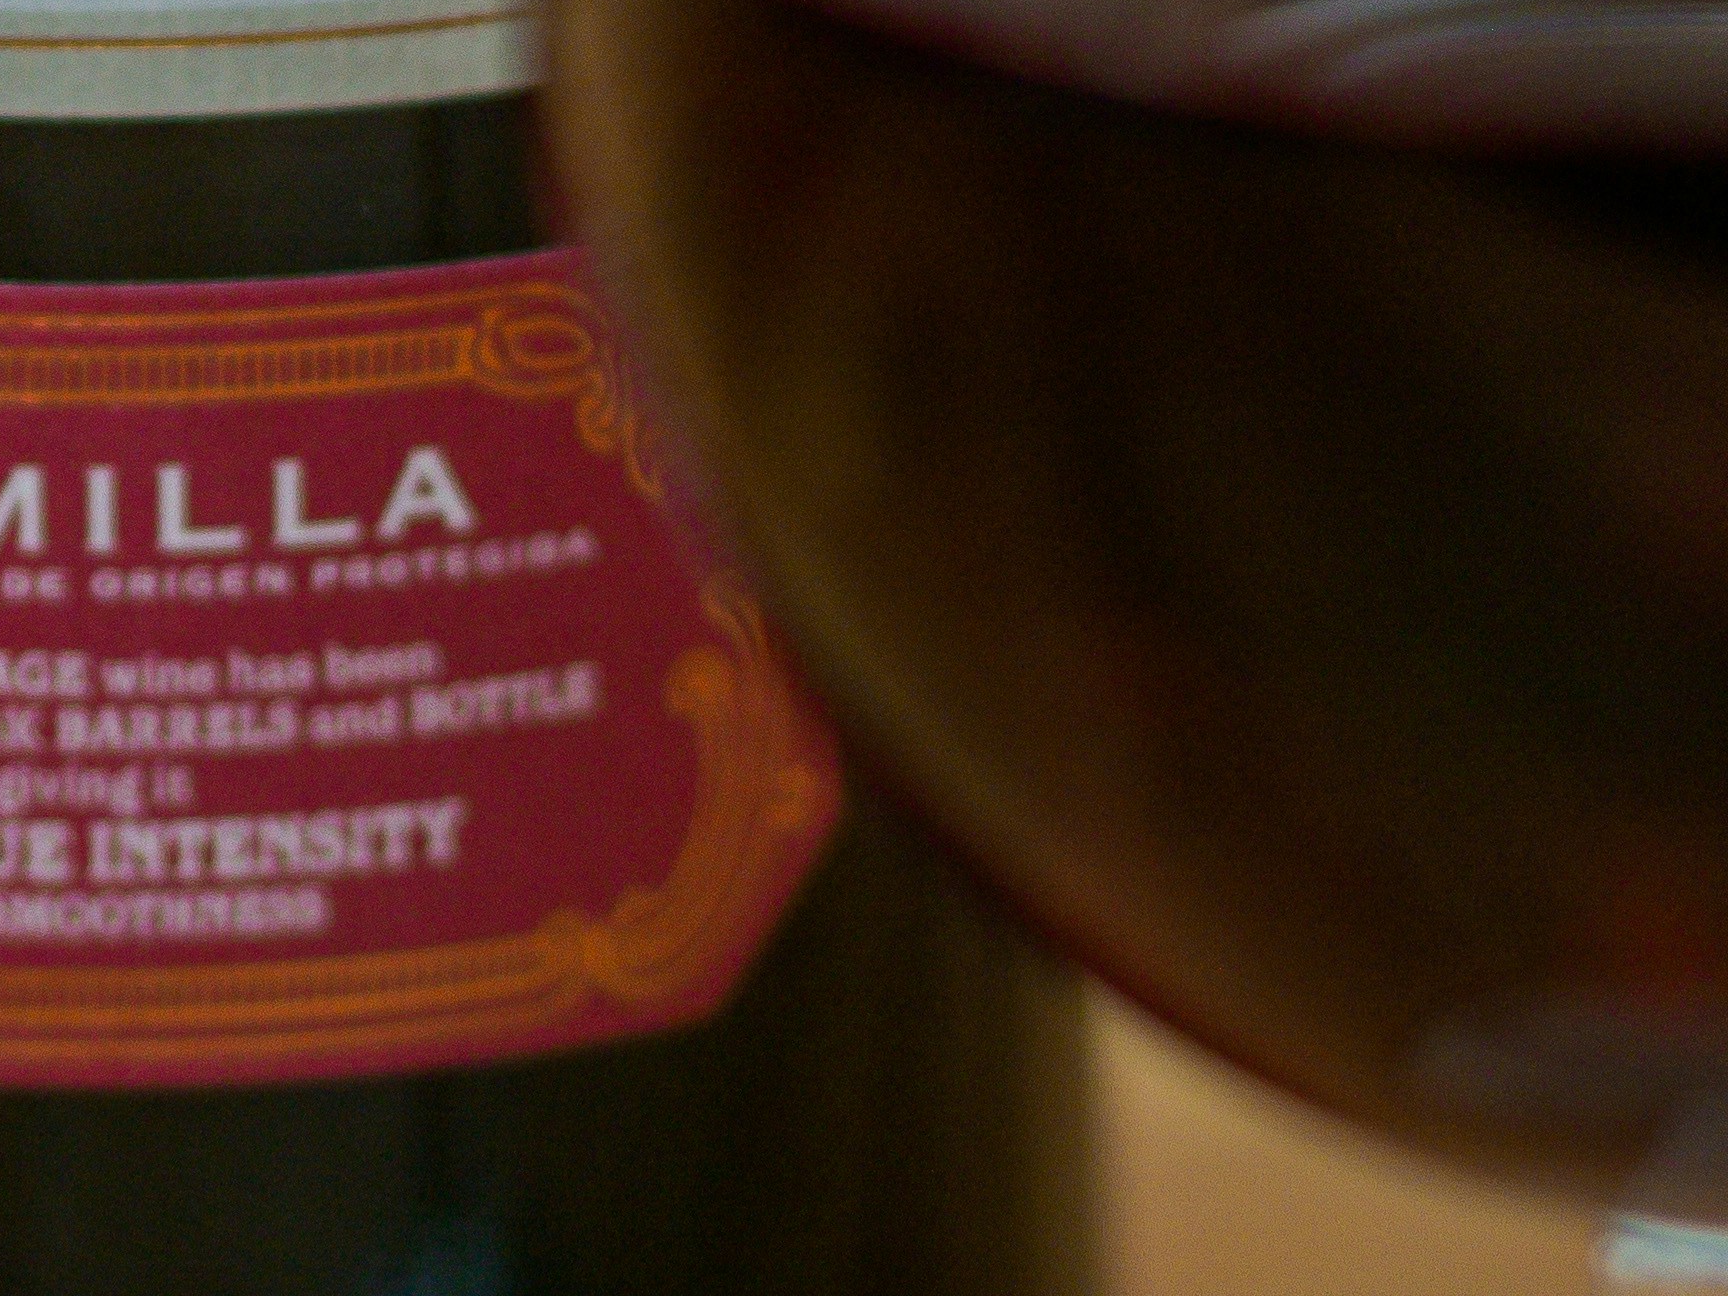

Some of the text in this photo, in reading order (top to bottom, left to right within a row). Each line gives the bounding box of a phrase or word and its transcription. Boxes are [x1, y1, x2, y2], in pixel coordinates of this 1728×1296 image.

[88, 564, 294, 603] ORIGEN
[100, 648, 218, 697] wine
[226, 646, 317, 692] has
[54, 700, 302, 755] BARRELS
[408, 659, 602, 742] BOTTLE
[87, 796, 466, 882] INTENSITY
